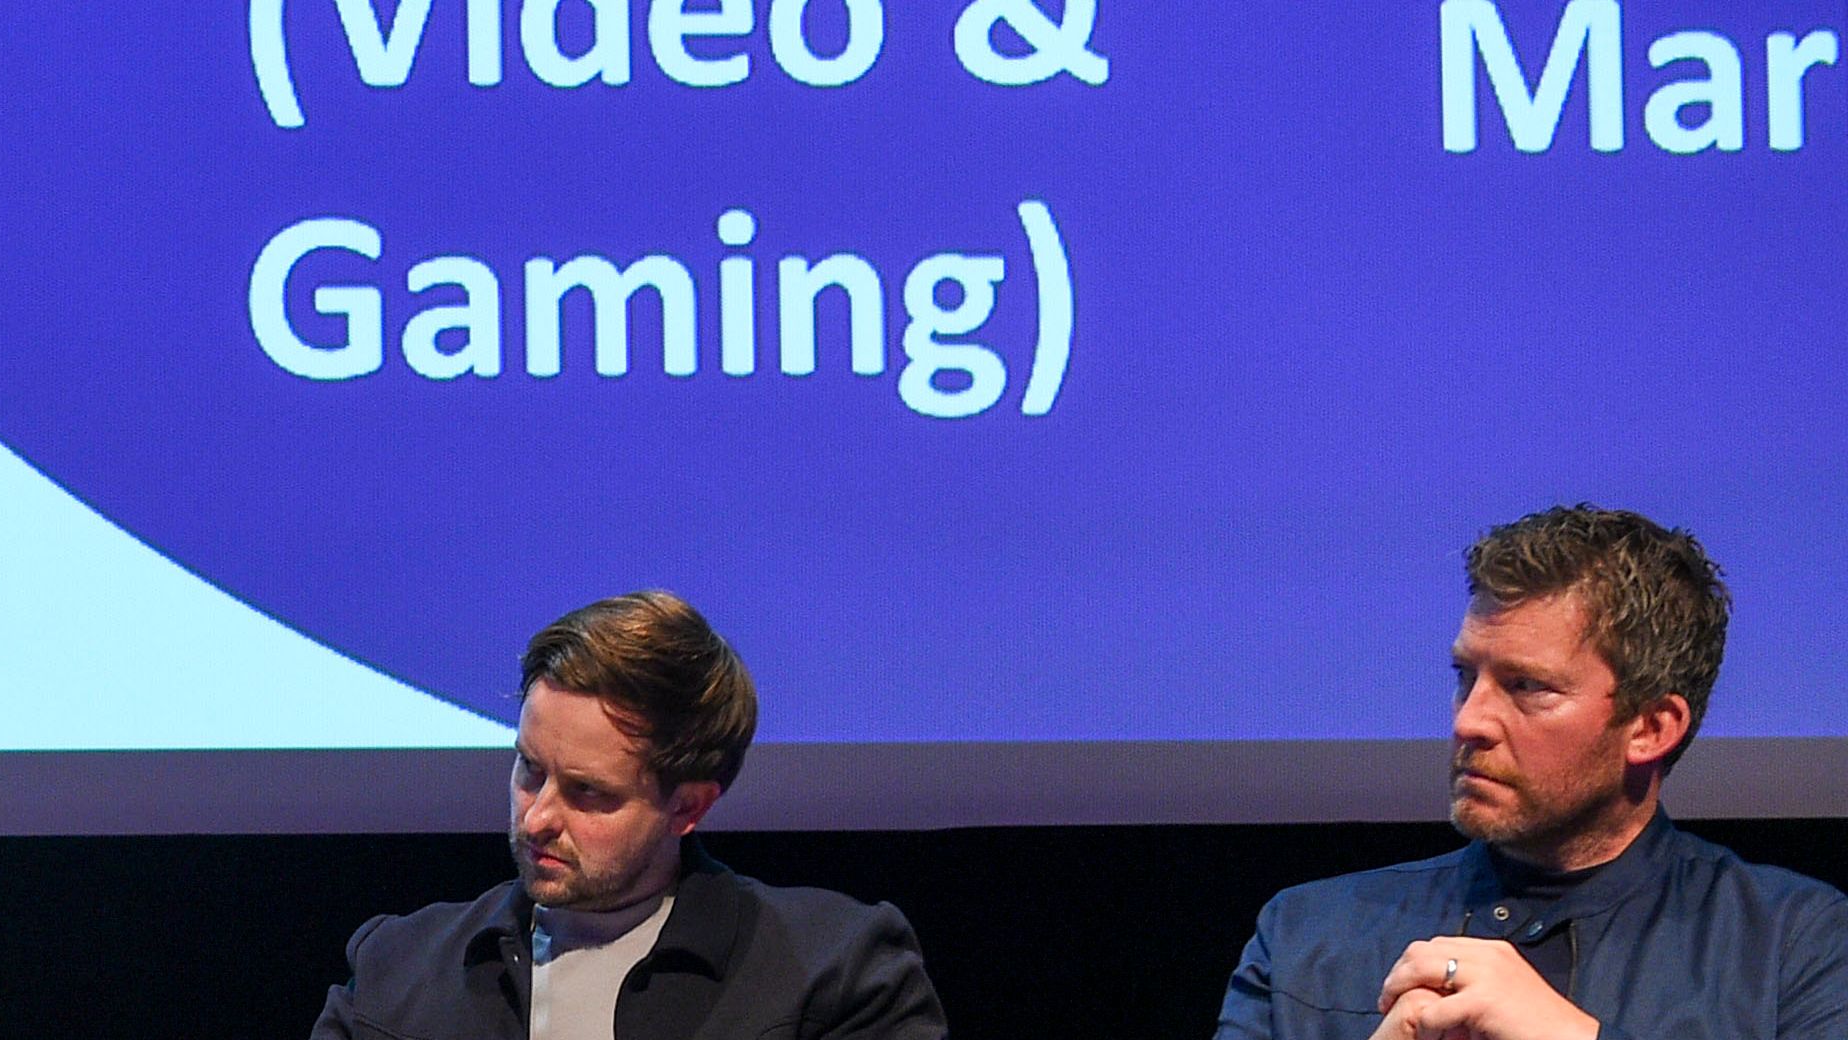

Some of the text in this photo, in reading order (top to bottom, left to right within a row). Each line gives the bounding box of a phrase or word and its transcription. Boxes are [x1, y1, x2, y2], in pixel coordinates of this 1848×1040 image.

[954, 0, 1109, 86] &
[1439, 0, 1839, 154] Mar
[248, 200, 1074, 418] Gaming)
